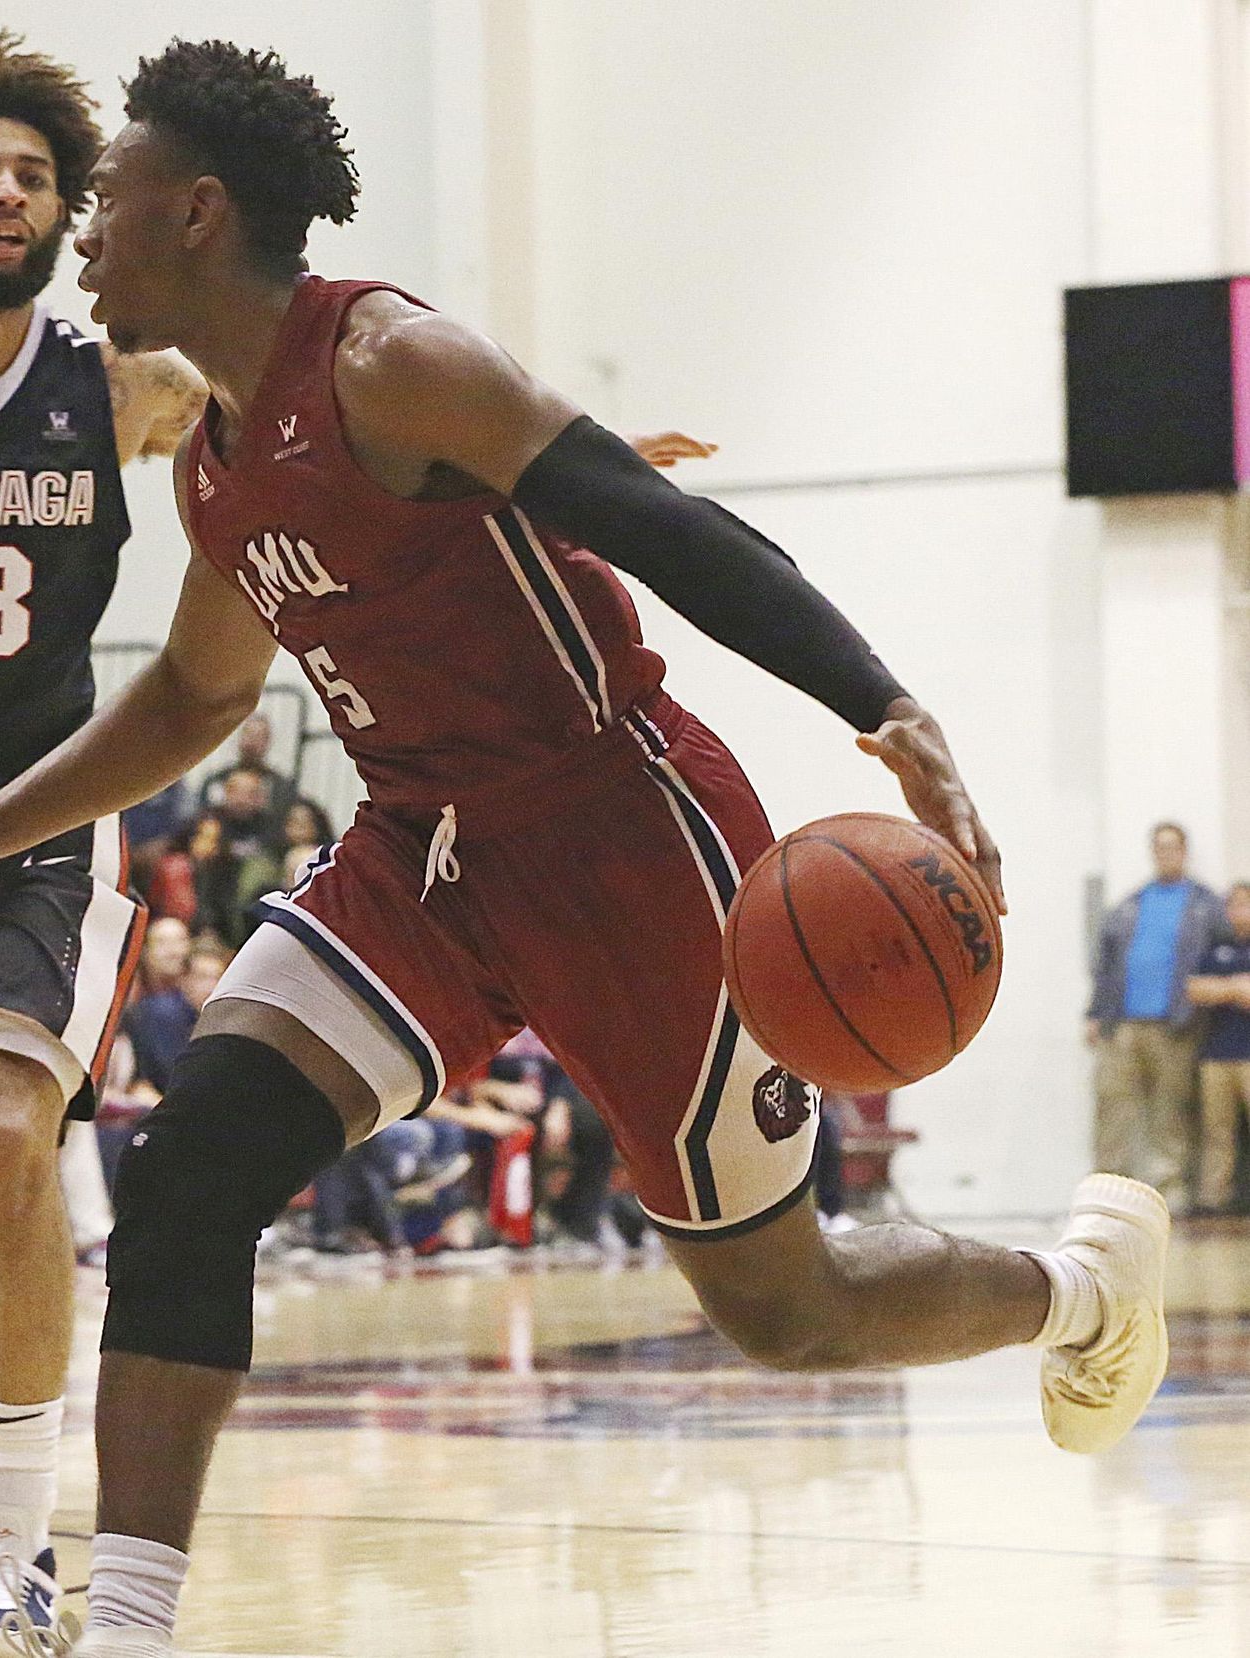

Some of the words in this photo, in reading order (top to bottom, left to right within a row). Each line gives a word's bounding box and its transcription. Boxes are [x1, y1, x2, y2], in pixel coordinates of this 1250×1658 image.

[236, 532, 349, 637] LMU
[303, 645, 377, 730] 5
[908, 854, 992, 972] NCAA
